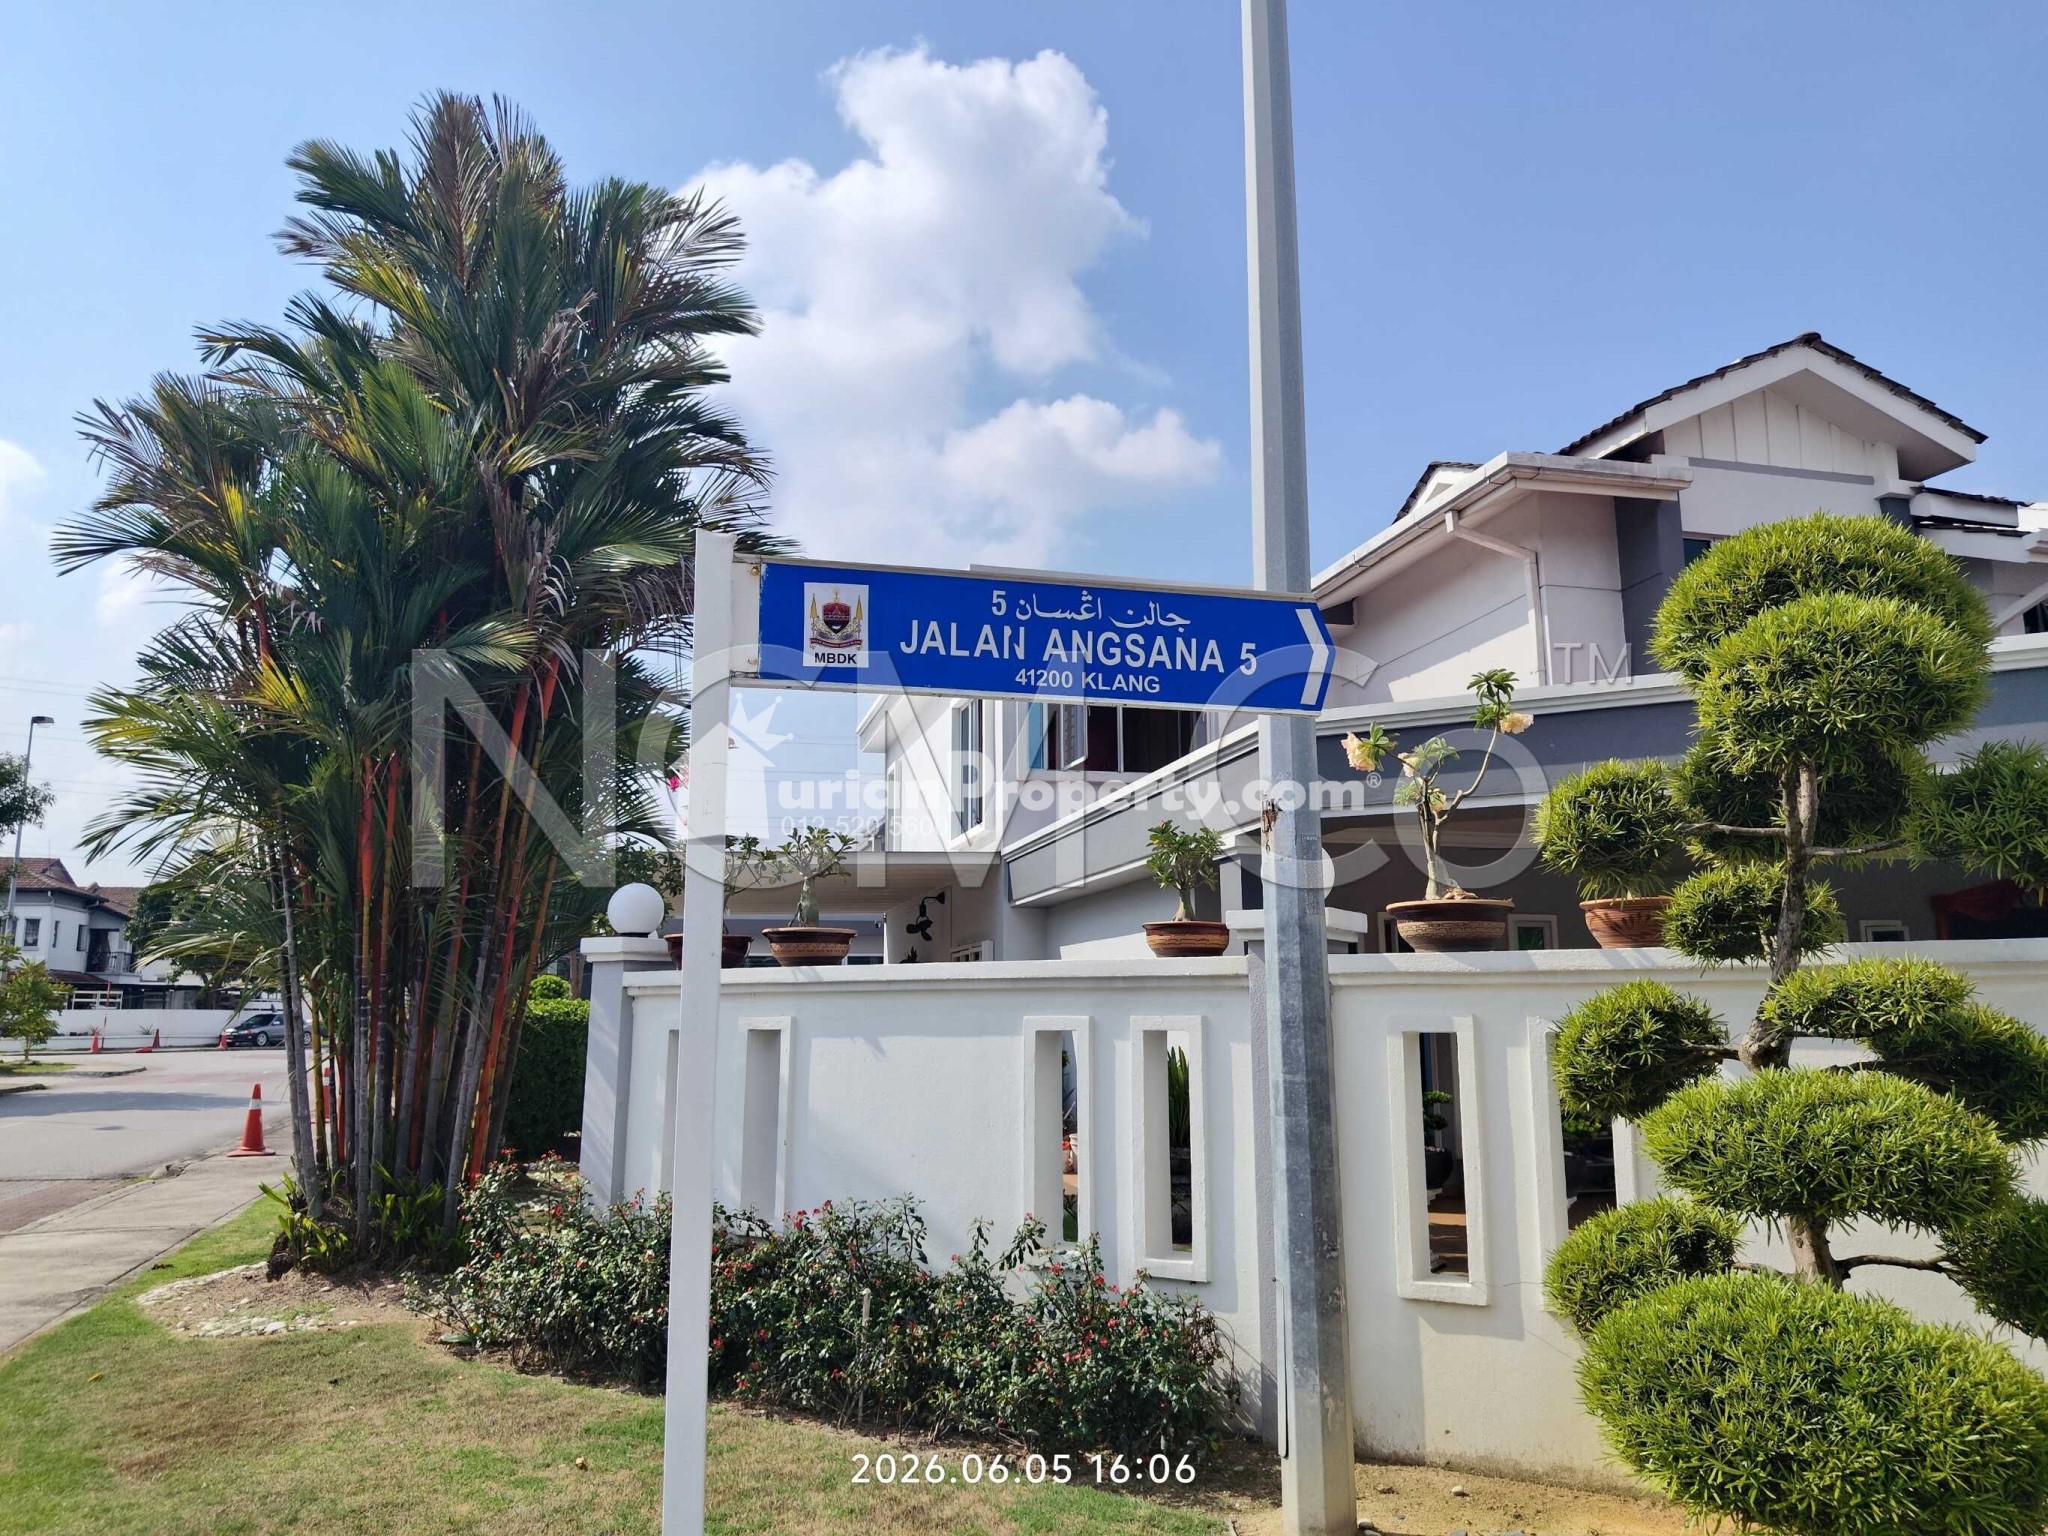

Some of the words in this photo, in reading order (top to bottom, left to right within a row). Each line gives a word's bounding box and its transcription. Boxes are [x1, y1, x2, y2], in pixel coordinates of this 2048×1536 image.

[991, 589, 1007, 616] 5
[1108, 601, 1191, 633] جالن
[814, 652, 857, 665] MBDK
[900, 619, 1026, 660] JALAN
[1042, 628, 1225, 673] ANGSANA
[1239, 642, 1258, 676] 5
[1014, 668, 1073, 688] 41200
[1081, 671, 1161, 694] KLANG
